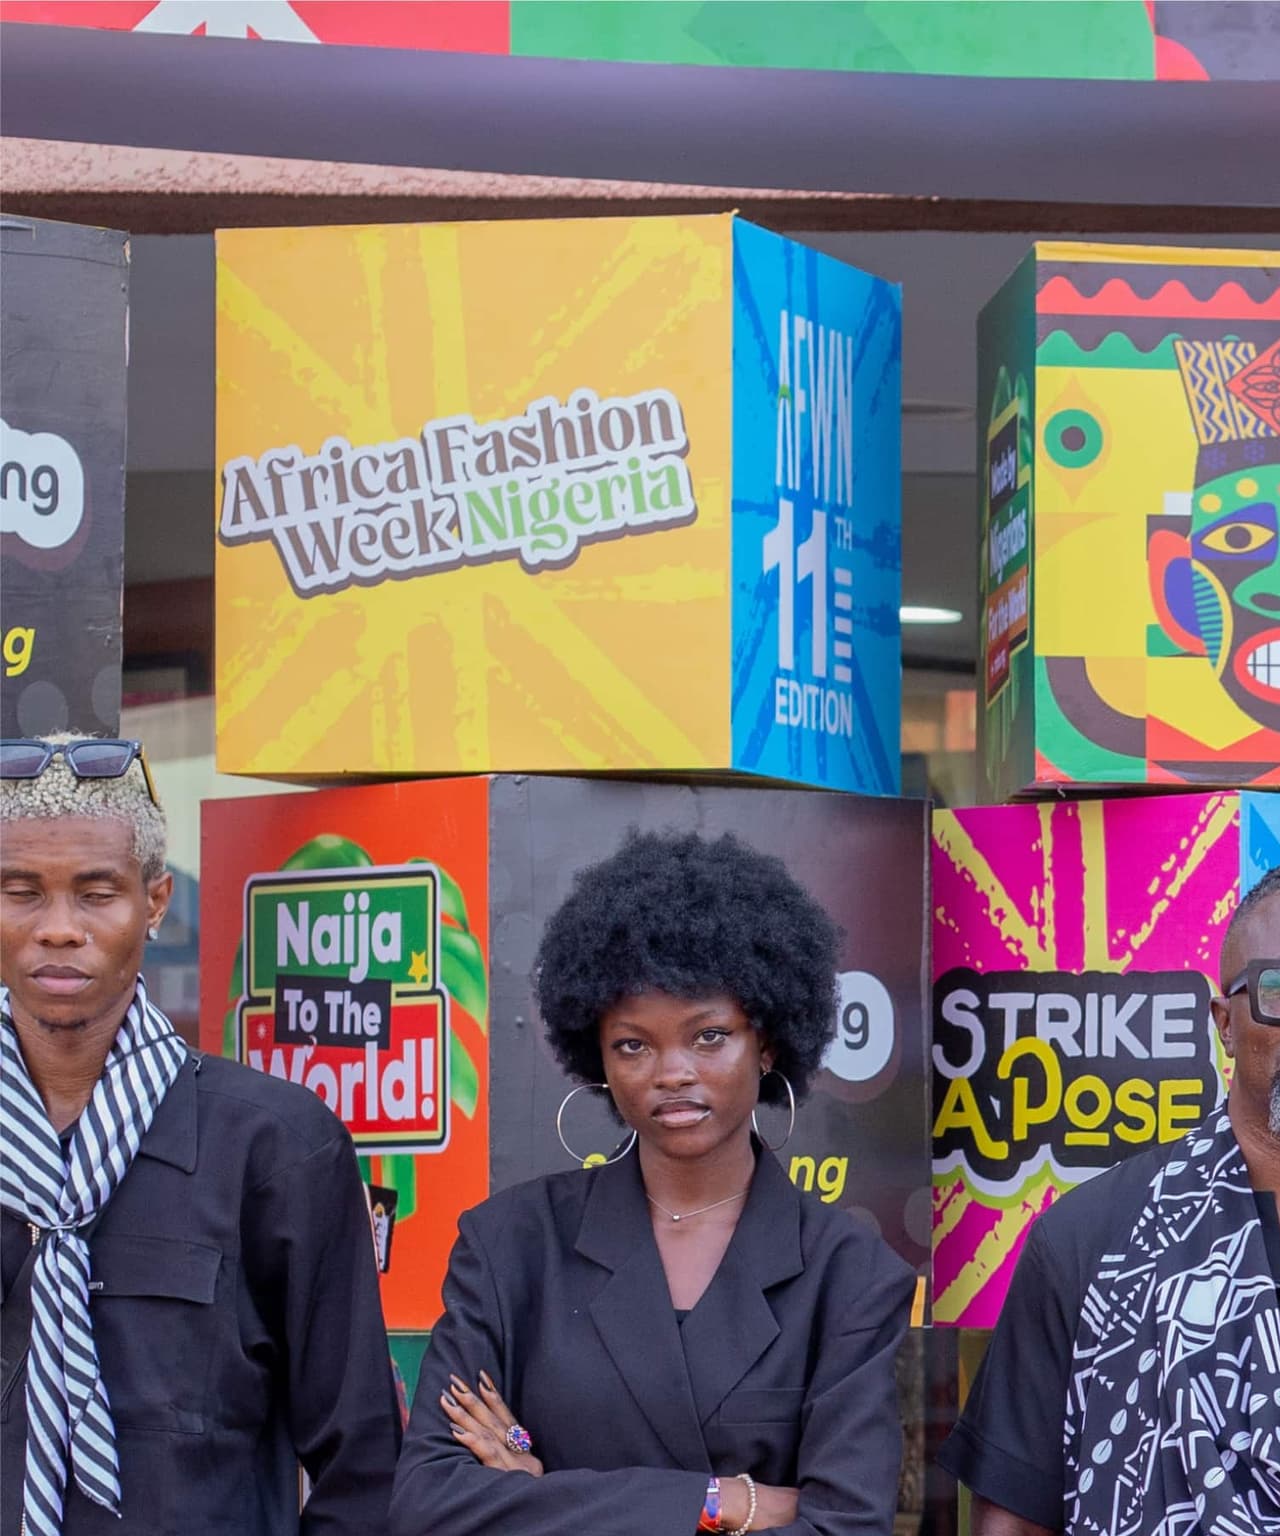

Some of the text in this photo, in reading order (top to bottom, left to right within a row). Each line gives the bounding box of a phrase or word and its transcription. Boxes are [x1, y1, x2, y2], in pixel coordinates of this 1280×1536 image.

[776, 309, 852, 507] AFWN
[230, 398, 676, 526] Africa Fashion
[285, 457, 685, 578] Week Nigeria
[775, 677, 852, 737] EDITION
[276, 892, 402, 984] Naija
[324, 990, 382, 1036] The
[932, 988, 1197, 1079] STRIKE
[932, 1036, 1203, 1160] A POSE
